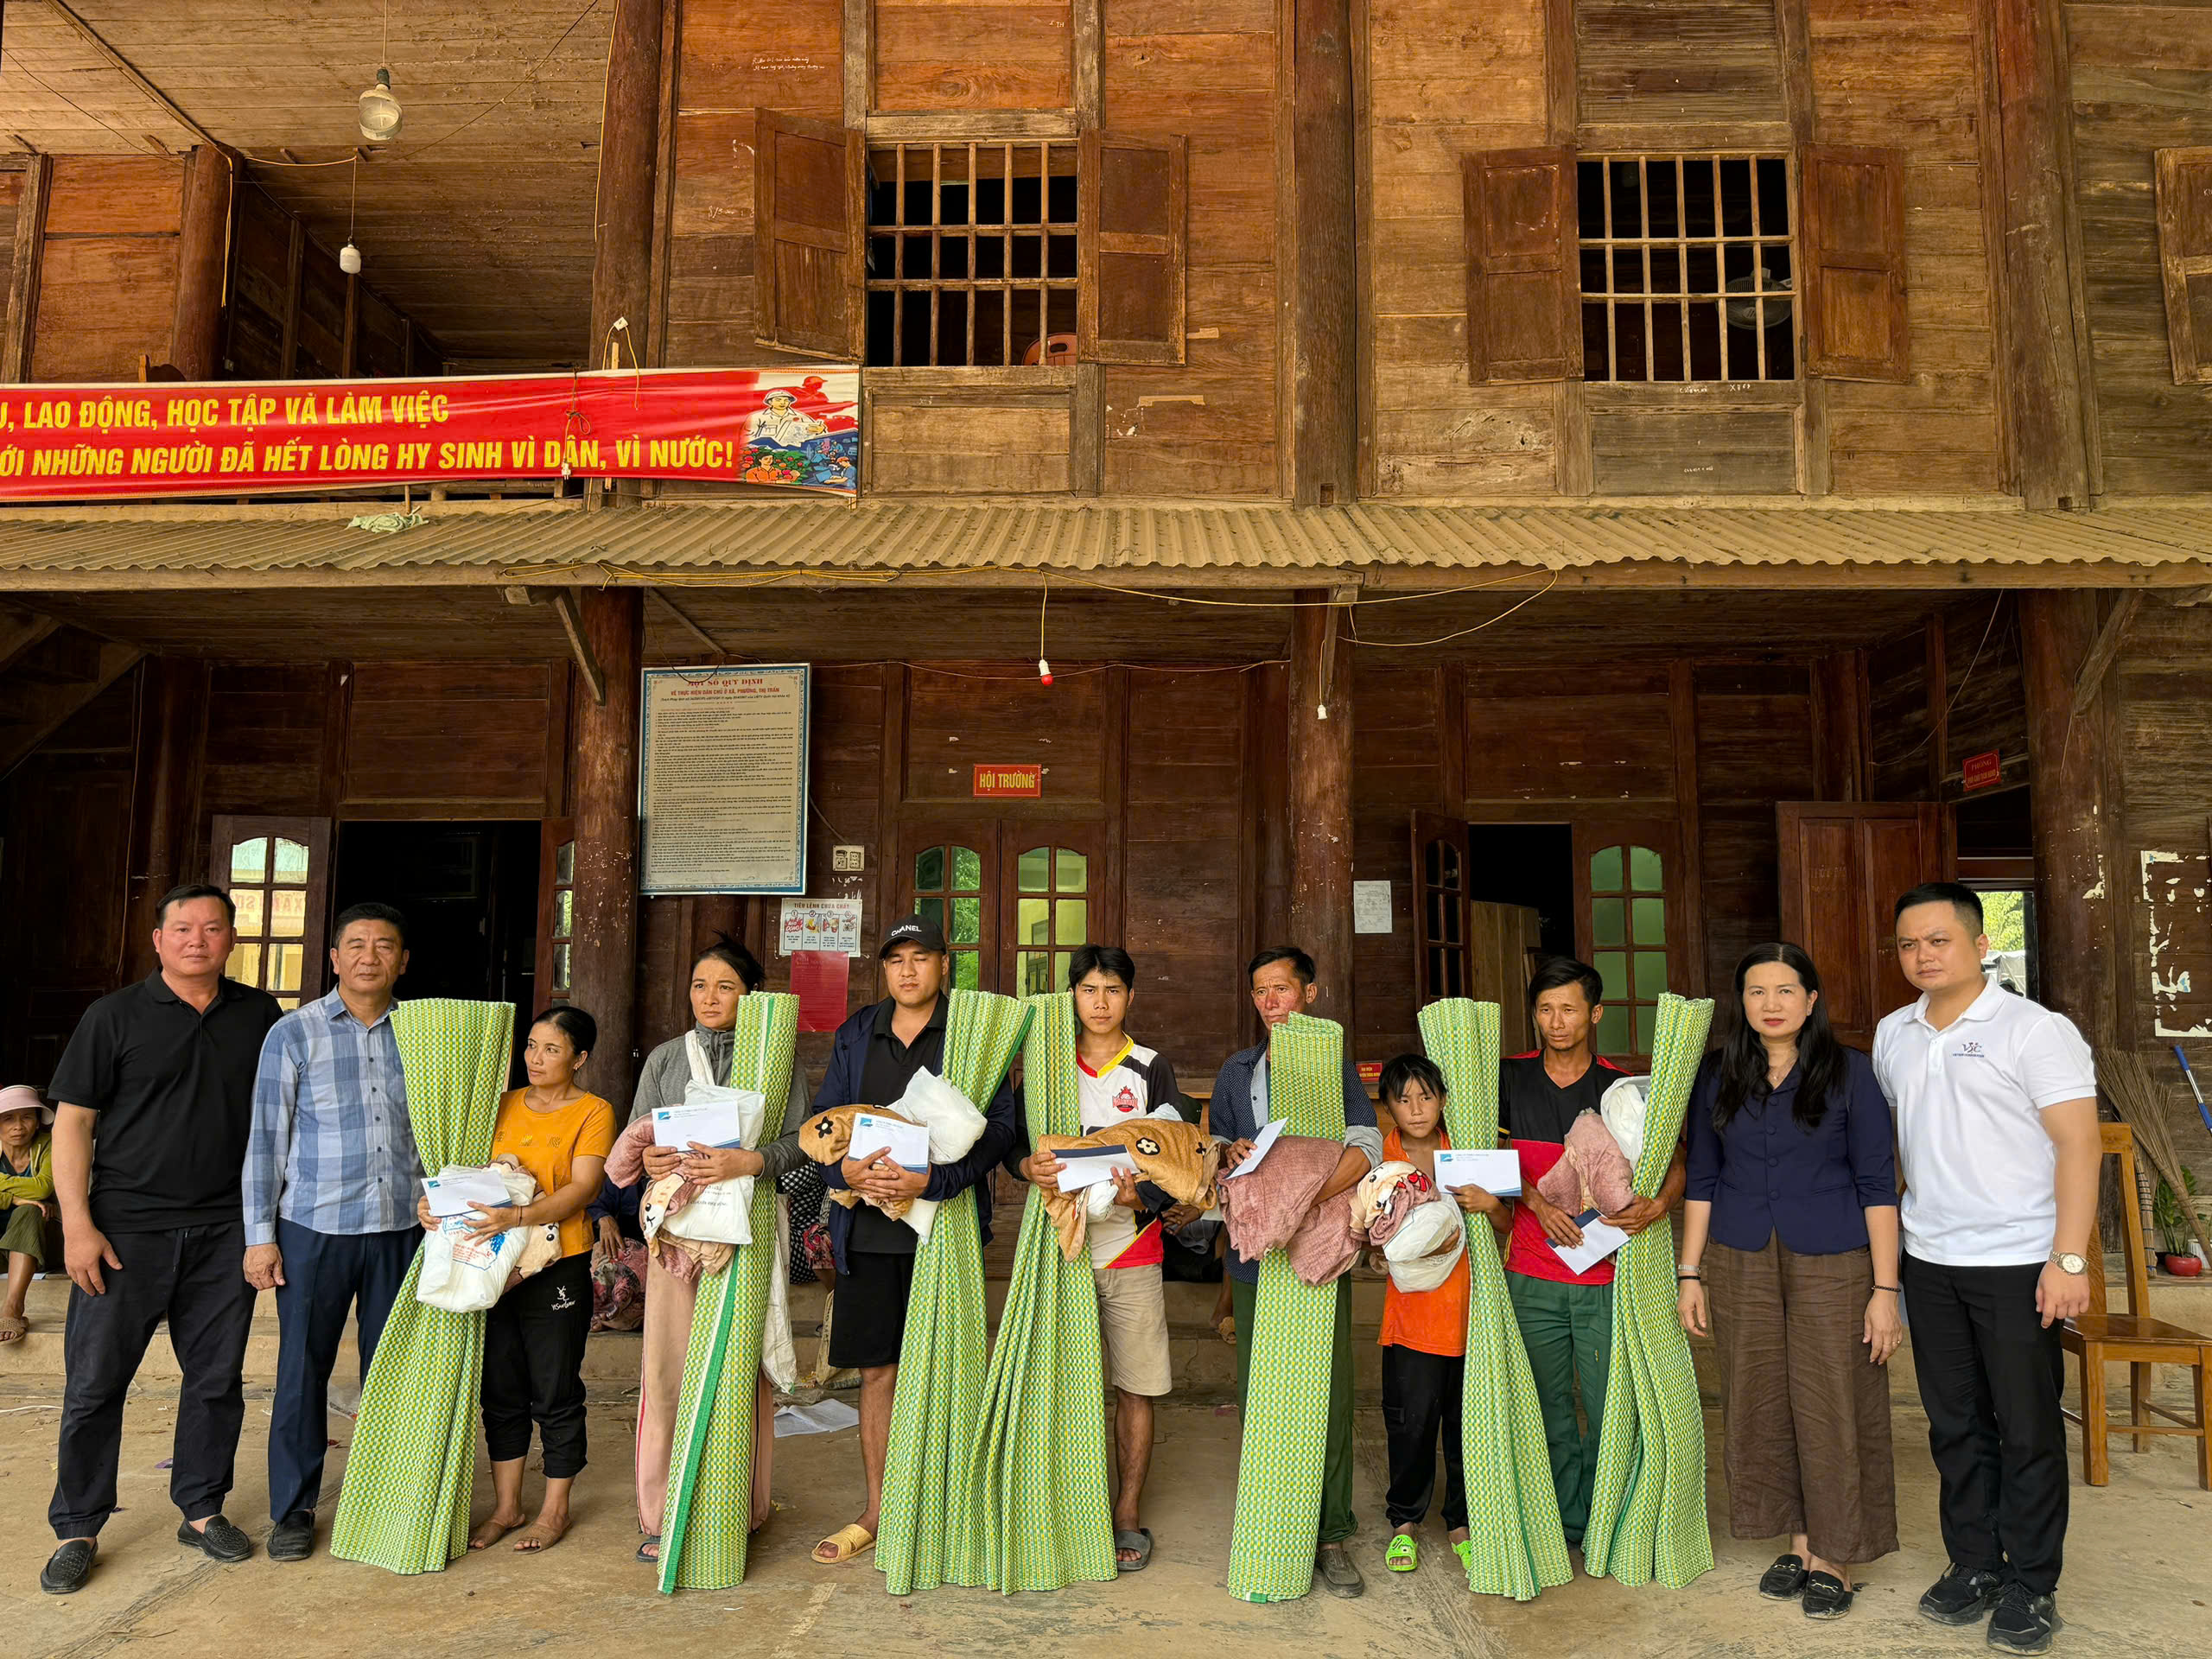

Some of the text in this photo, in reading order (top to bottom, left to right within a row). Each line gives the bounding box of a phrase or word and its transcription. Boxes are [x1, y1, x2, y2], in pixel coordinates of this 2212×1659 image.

[23, 401, 72, 429] LAO
[79, 395, 158, 434] ĐỘNG,
[167, 398, 219, 433] HỌC
[227, 393, 276, 432] TẬP
[285, 391, 318, 425] VÀ
[326, 391, 383, 425] LÀM
[391, 390, 449, 429] VIỆC
[31, 443, 124, 476] NHỮNG
[130, 441, 214, 474] NGƯỜI
[219, 441, 255, 474] ĐÃ
[263, 436, 313, 472] HẾT
[319, 438, 389, 471] LÒNG
[396, 443, 432, 469] HY
[438, 442, 503, 469] SINH
[511, 435, 535, 468] VÌ
[543, 434, 607, 471] DÂN,
[615, 435, 640, 468] VÌ
[649, 435, 733, 468] NƯỚC!
[979, 770, 1036, 791] HỘI TRƯỜNG
[891, 925, 922, 937] CHANEL
